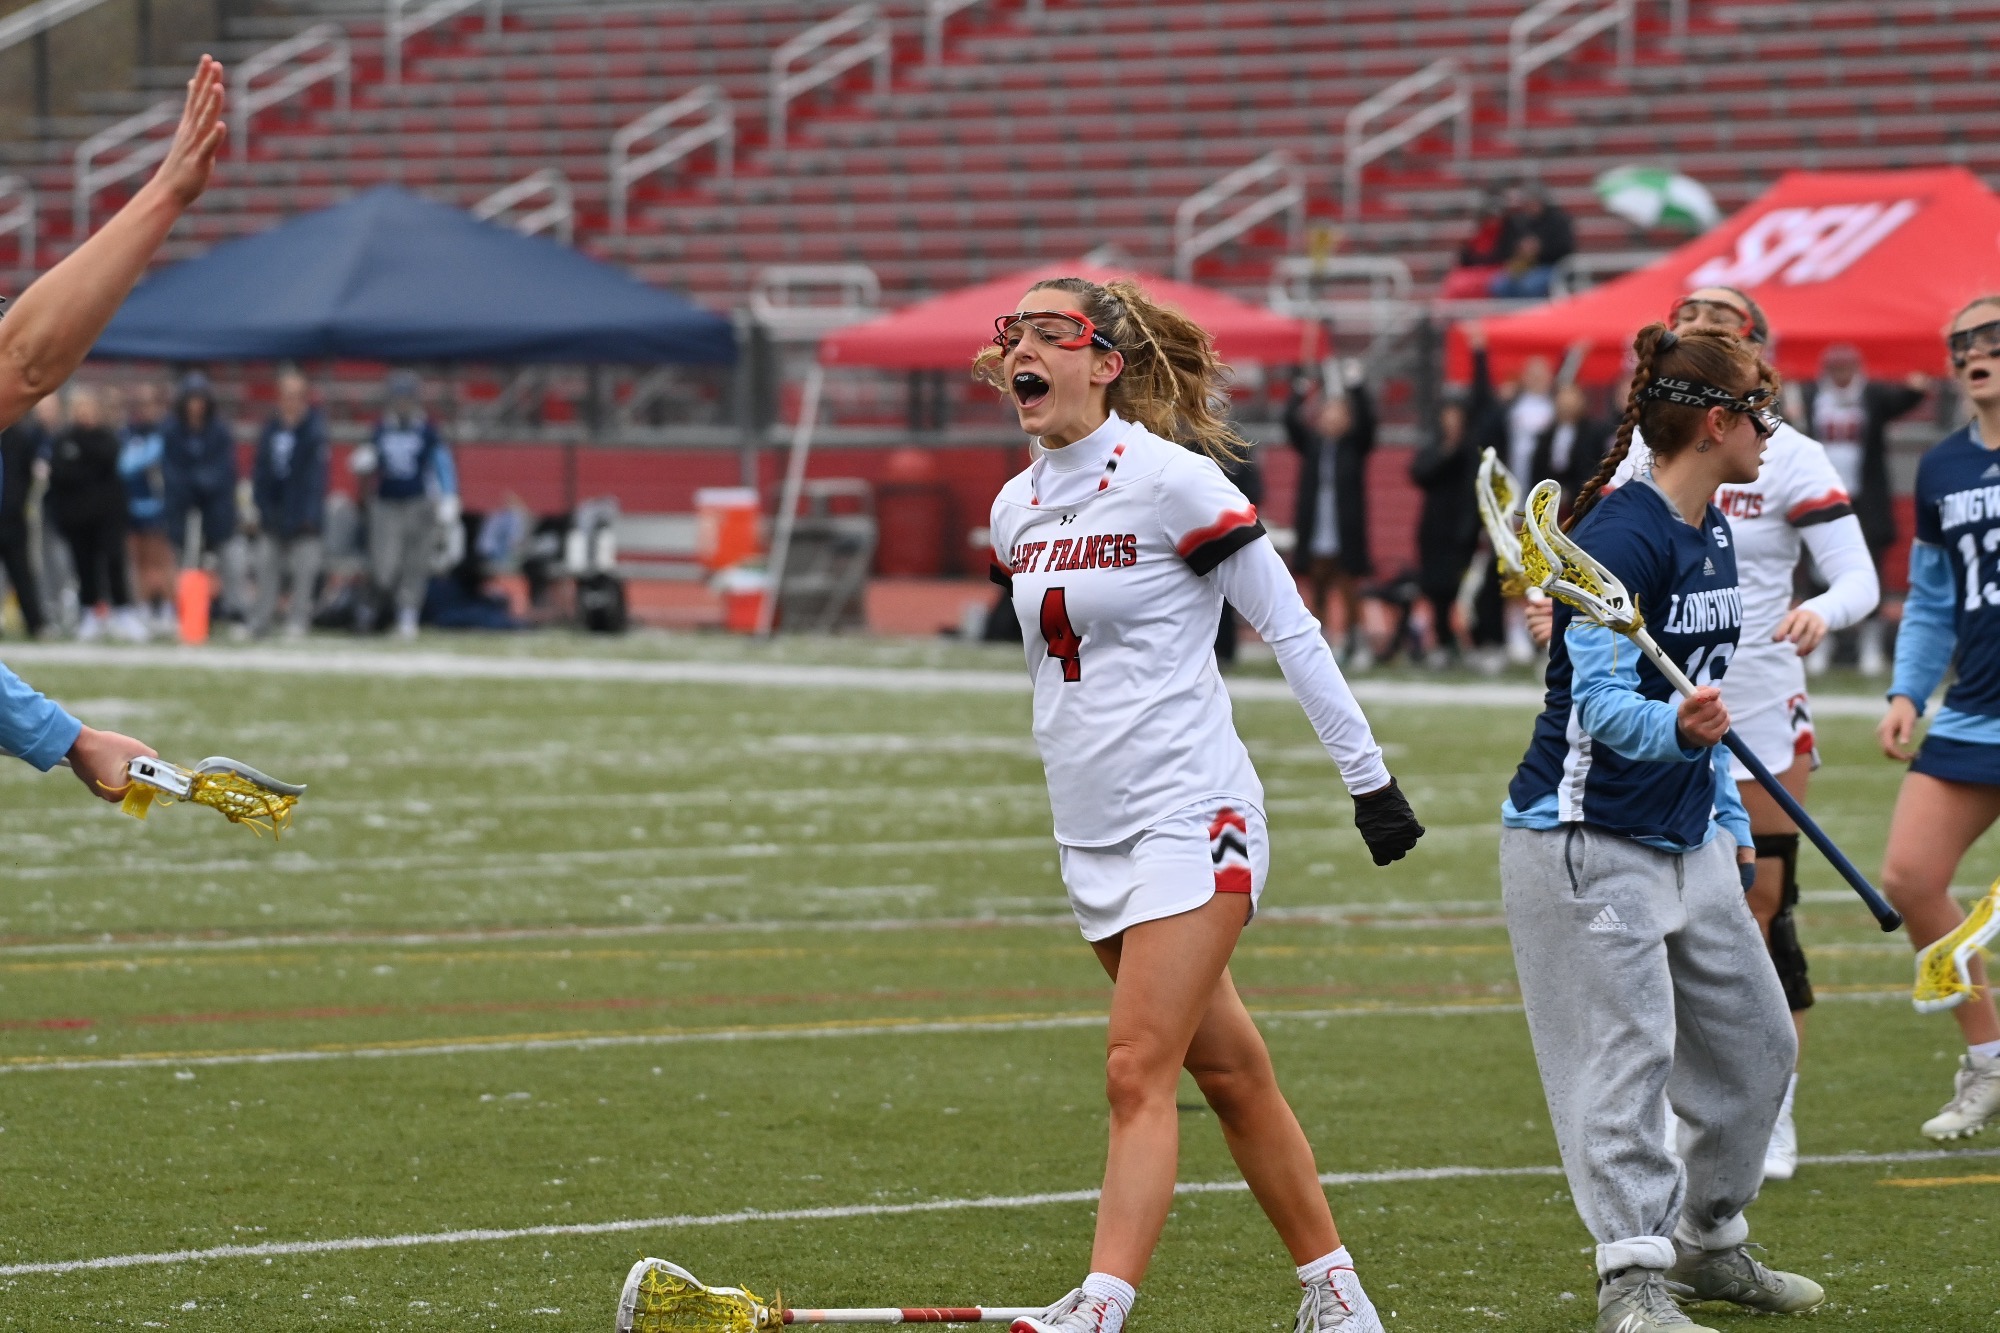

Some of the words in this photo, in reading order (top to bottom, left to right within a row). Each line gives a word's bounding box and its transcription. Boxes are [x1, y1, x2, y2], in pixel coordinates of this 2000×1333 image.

[1669, 391, 1707, 406] STX
[1712, 525, 1729, 548] S
[1044, 534, 1137, 572] FRANCIS
[1039, 586, 1082, 682] 4
[1589, 921, 1628, 930] adidas
